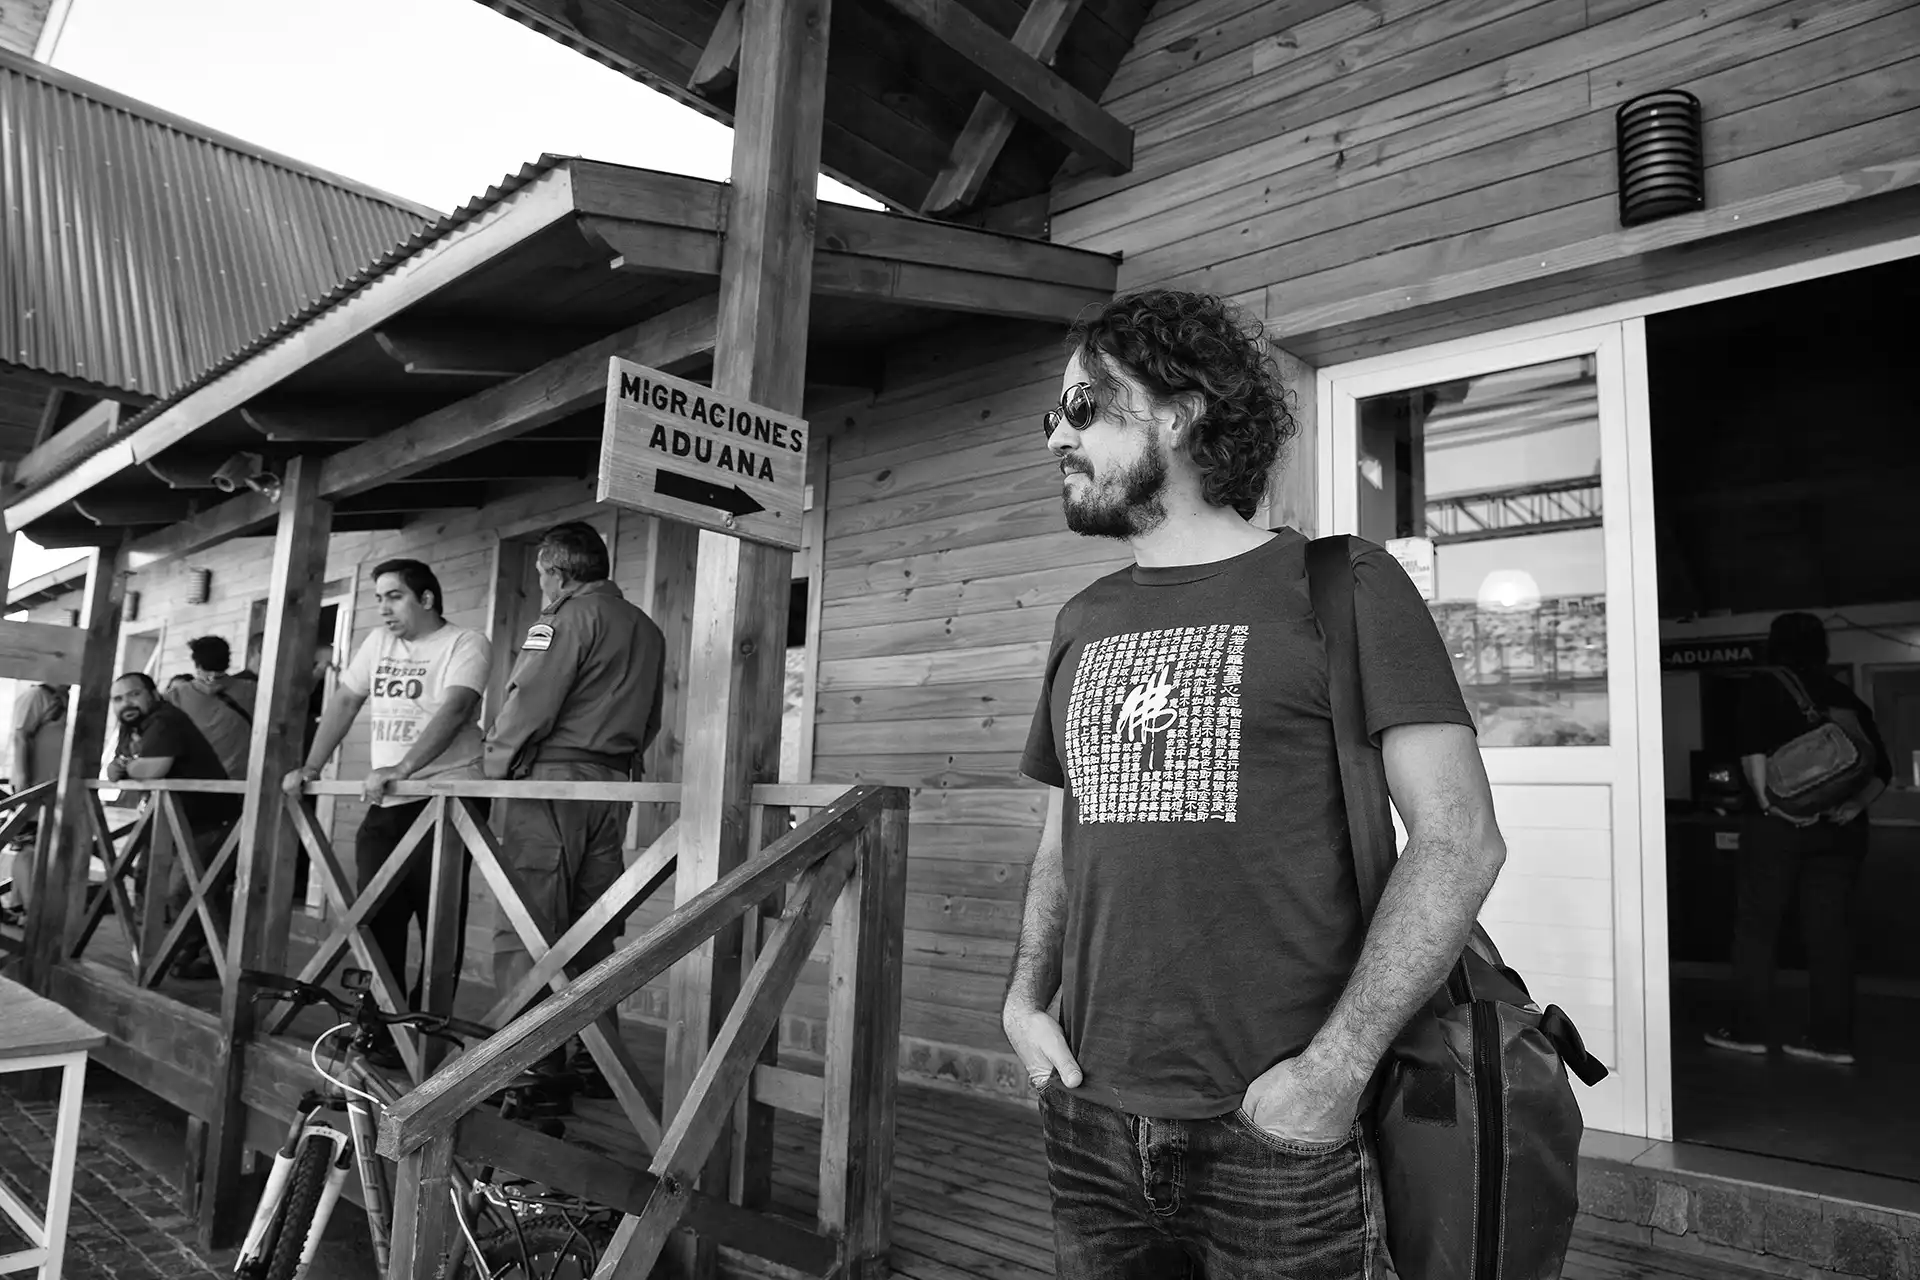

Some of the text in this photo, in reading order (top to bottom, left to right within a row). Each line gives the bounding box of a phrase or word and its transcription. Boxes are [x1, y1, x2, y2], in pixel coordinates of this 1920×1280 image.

[620, 371, 803, 453] MIGRACIONES
[649, 424, 774, 482] ADUANA
[1672, 647, 1752, 664] ADUANA
[374, 677, 423, 700] EGO
